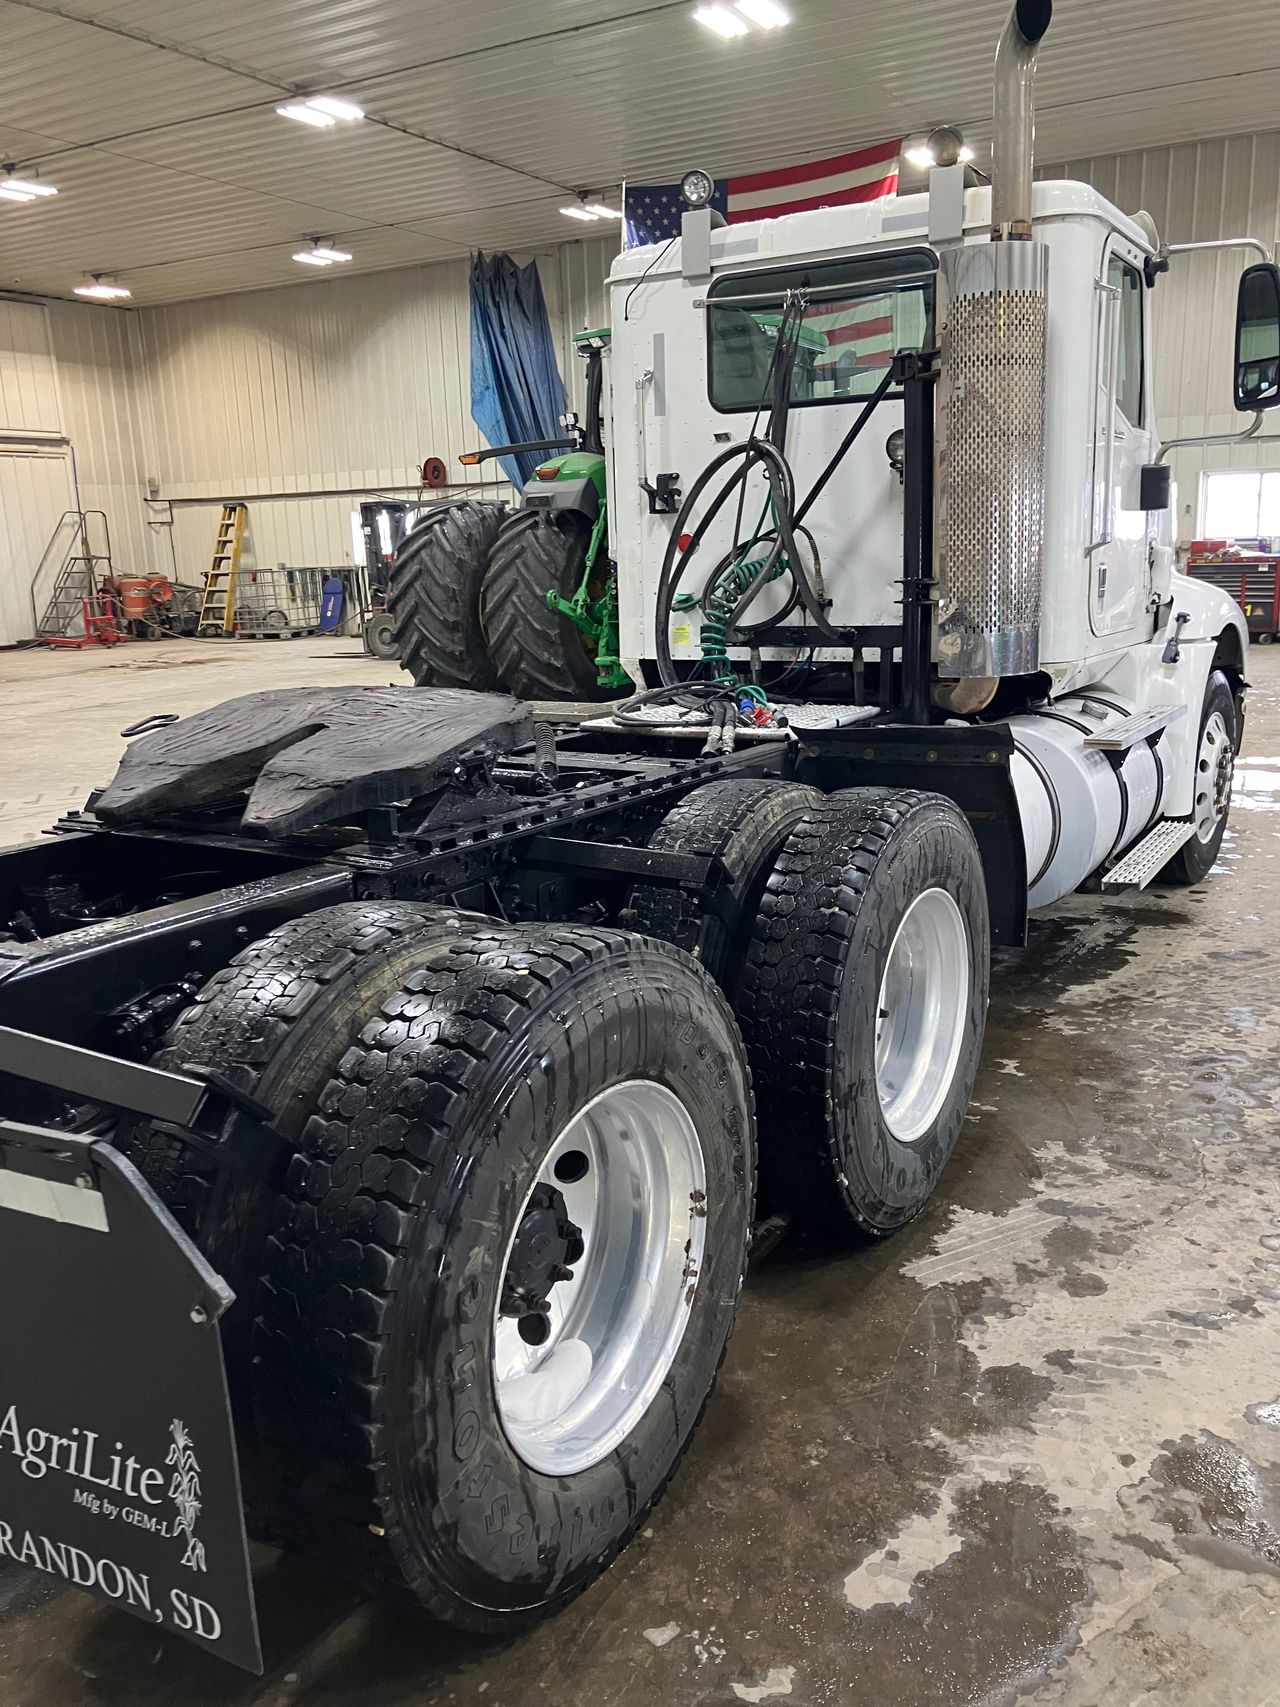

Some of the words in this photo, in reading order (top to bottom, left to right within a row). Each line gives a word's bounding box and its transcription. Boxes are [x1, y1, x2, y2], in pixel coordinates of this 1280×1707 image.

[1244, 604, 1253, 617] 1
[0, 1405, 165, 1505] AgriLite
[73, 1488, 101, 1514] Mfg
[103, 1498, 119, 1520] by
[122, 1507, 171, 1538] GEM-L
[0, 1521, 163, 1623] RANDON,
[170, 1588, 222, 1640] SD
